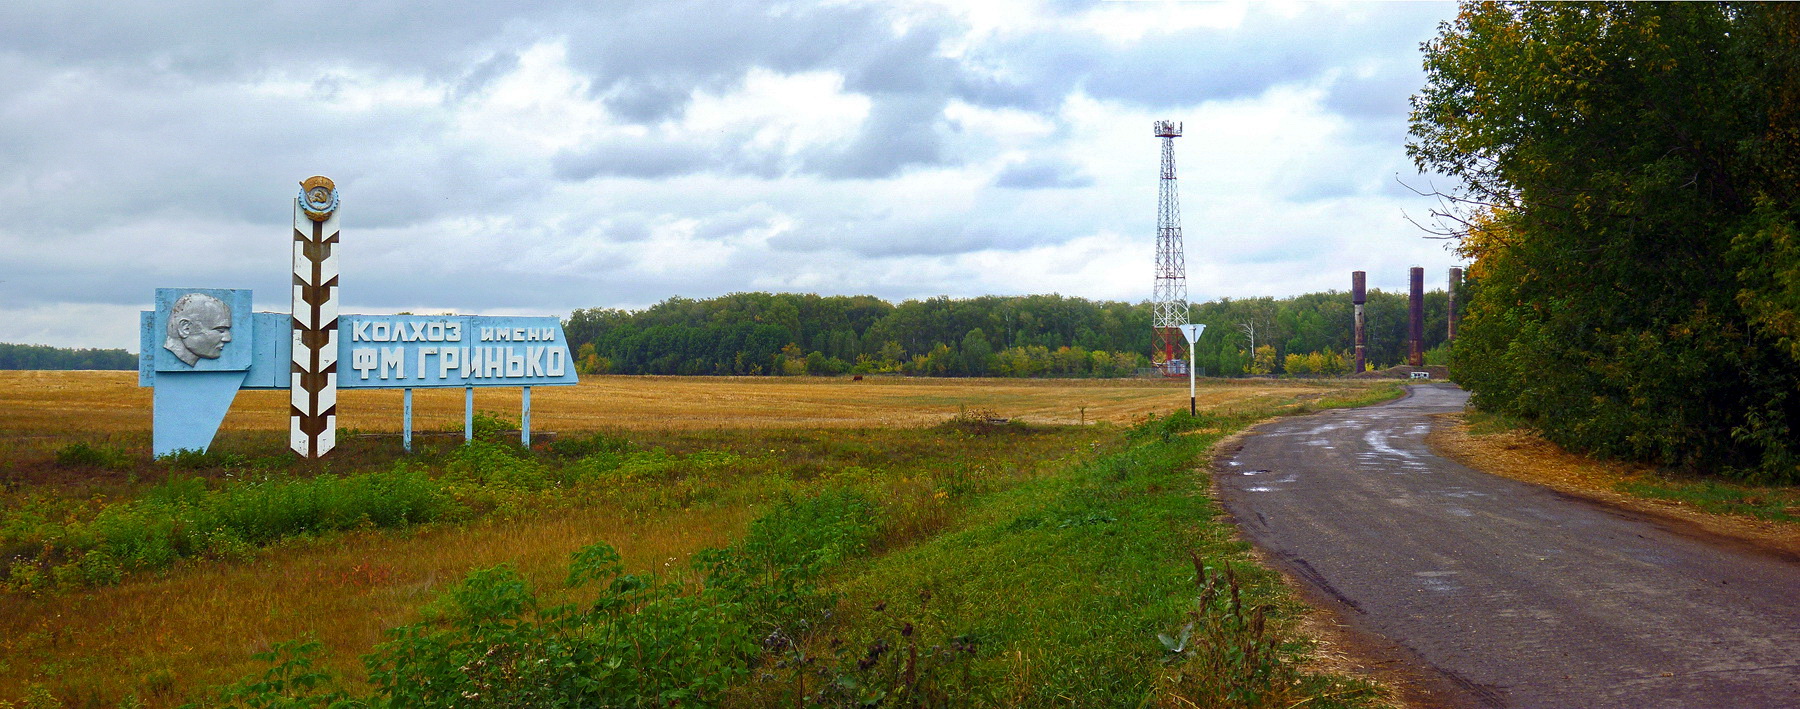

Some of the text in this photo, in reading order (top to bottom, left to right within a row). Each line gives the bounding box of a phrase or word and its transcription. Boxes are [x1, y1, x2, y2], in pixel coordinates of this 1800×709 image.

[352, 322, 555, 342] КОЛХОЗ ИМЕНИ
[417, 347, 565, 379] ГРИНЬКО
